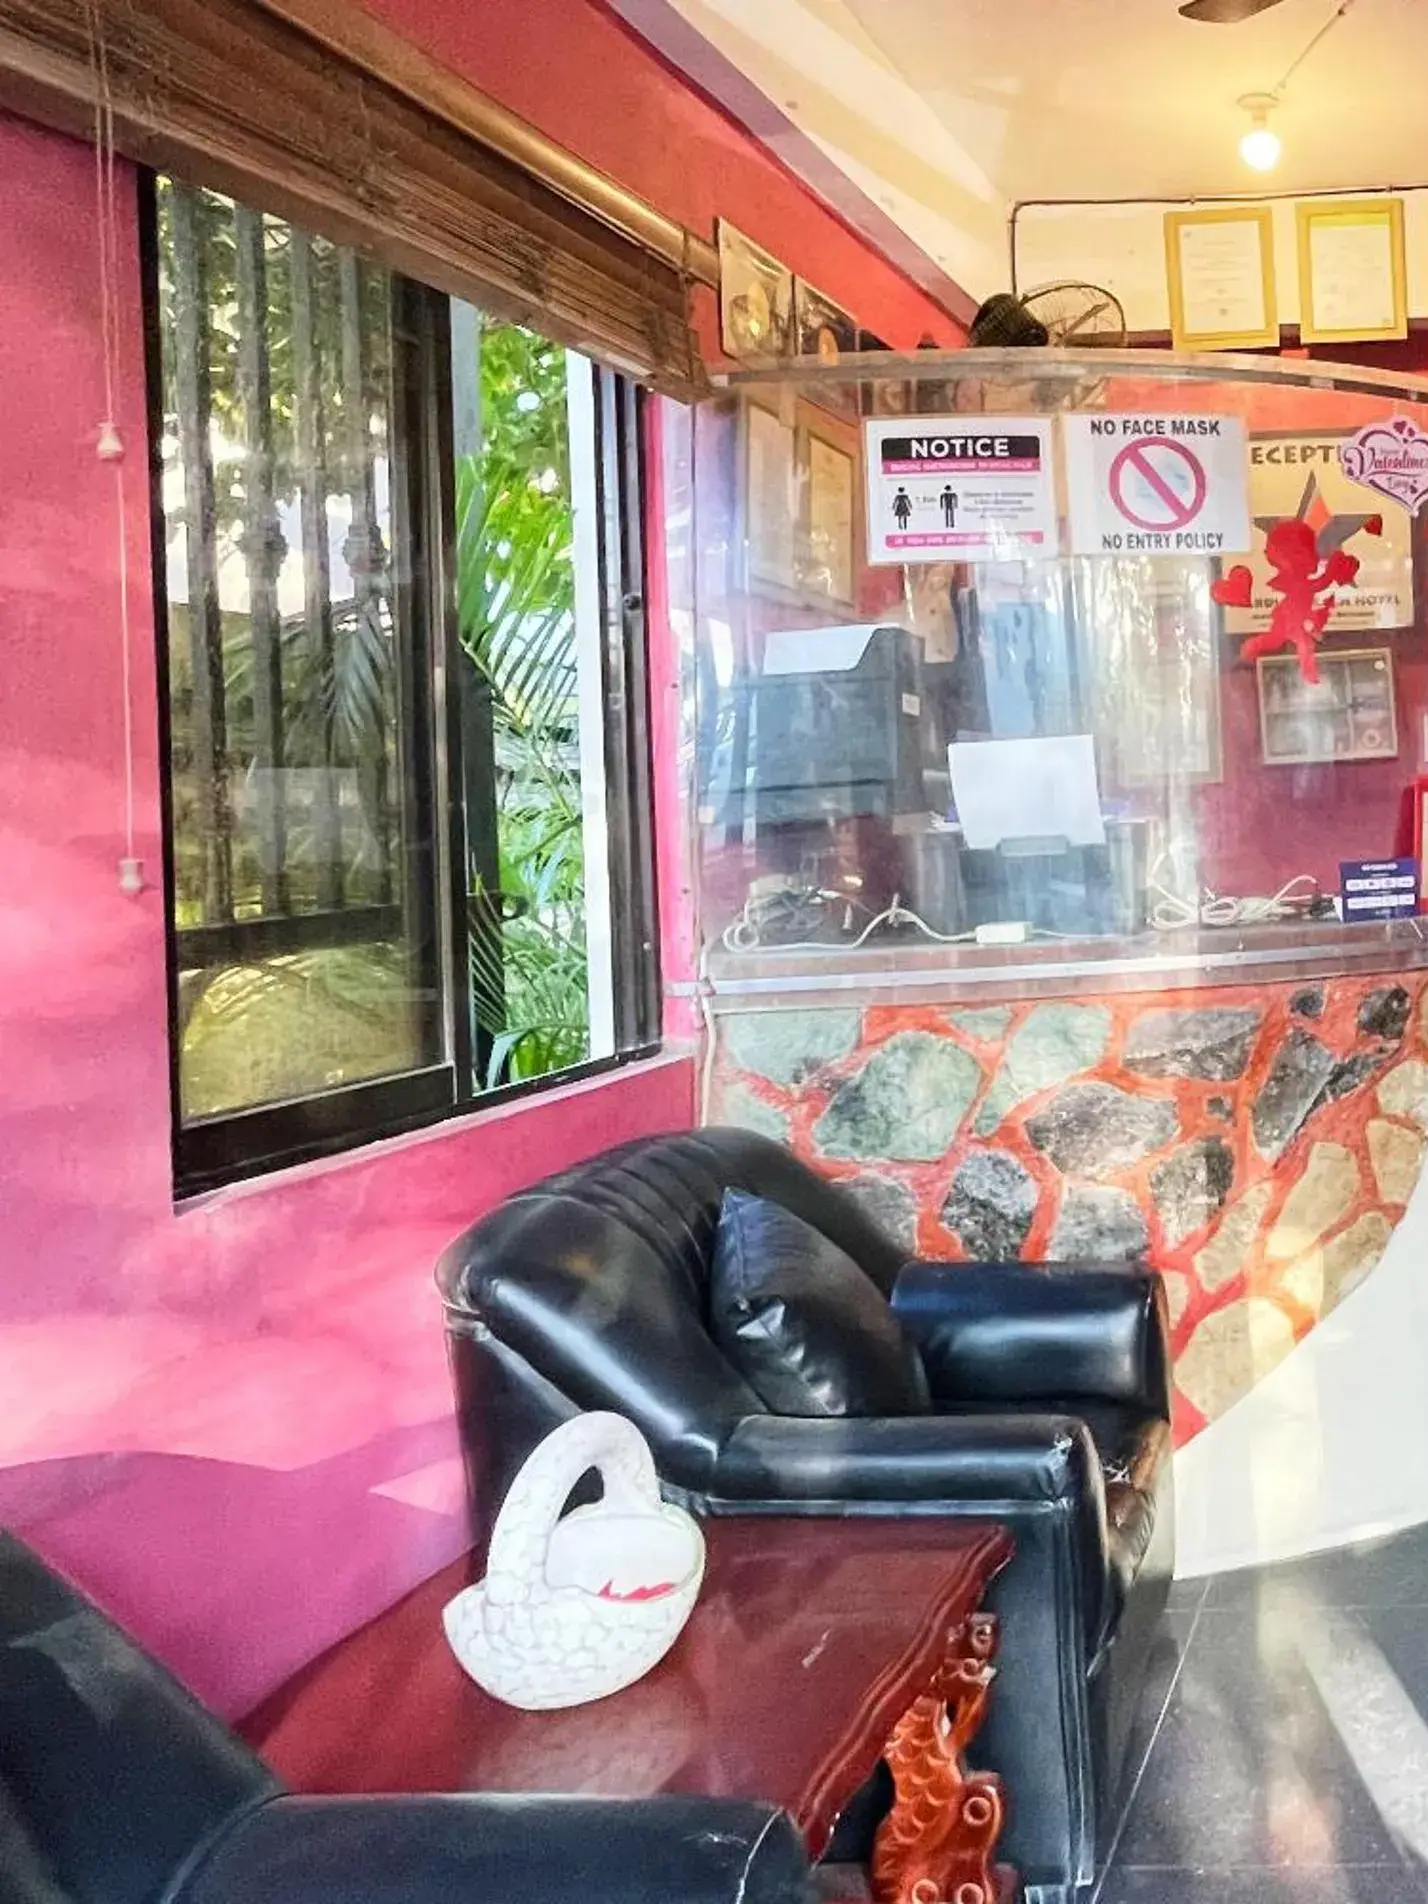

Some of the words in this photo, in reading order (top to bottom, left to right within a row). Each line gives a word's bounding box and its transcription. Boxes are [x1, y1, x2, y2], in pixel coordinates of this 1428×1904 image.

[1090, 420, 1116, 436] NO
[1122, 420, 1166, 436] FACE
[1171, 420, 1221, 436] MASK
[911, 438, 1010, 459] NOTICE
[1250, 444, 1343, 465] ECEPTI
[1102, 533, 1122, 549] NO
[1126, 533, 1172, 549] ENTRY
[1175, 532, 1224, 549] POLICY
